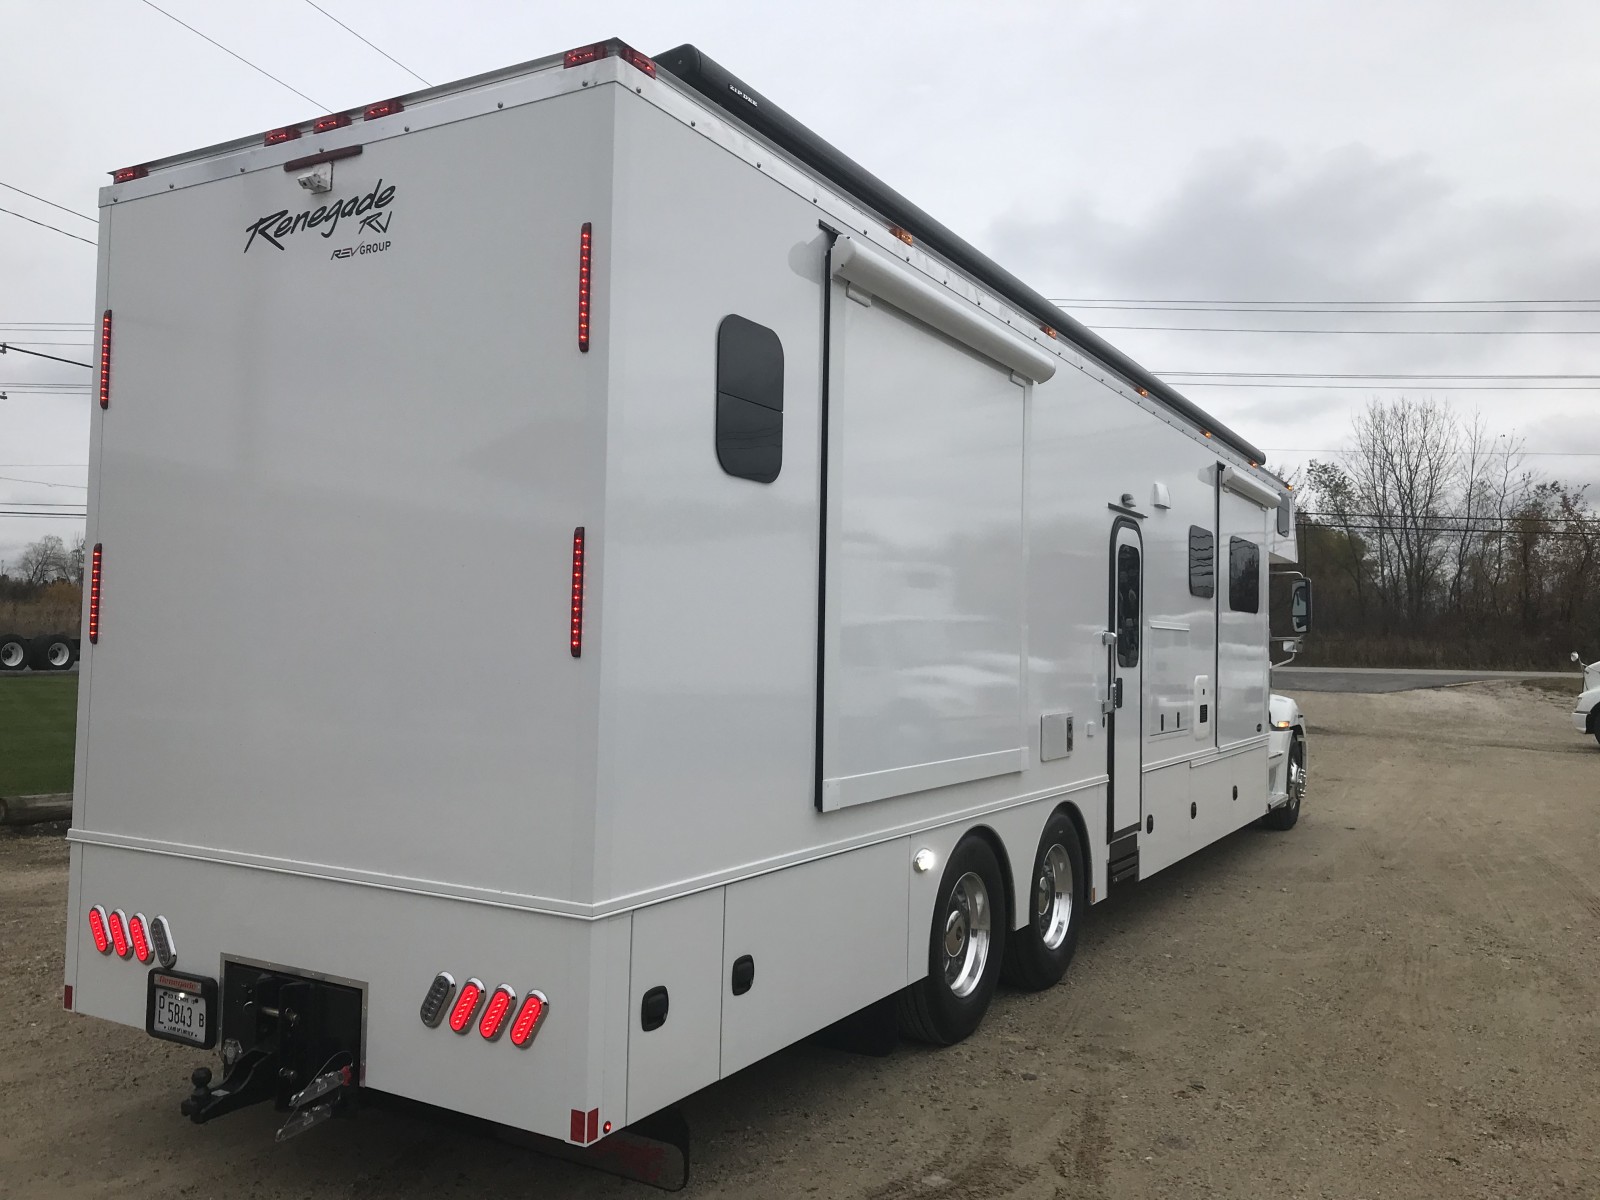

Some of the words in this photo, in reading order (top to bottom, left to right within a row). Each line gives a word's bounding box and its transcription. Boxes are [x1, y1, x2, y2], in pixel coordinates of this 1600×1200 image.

[729, 84, 743, 96] ZIP
[243, 178, 396, 254] Renegade
[358, 210, 393, 235] RV
[168, 1002, 193, 1028] 5843
